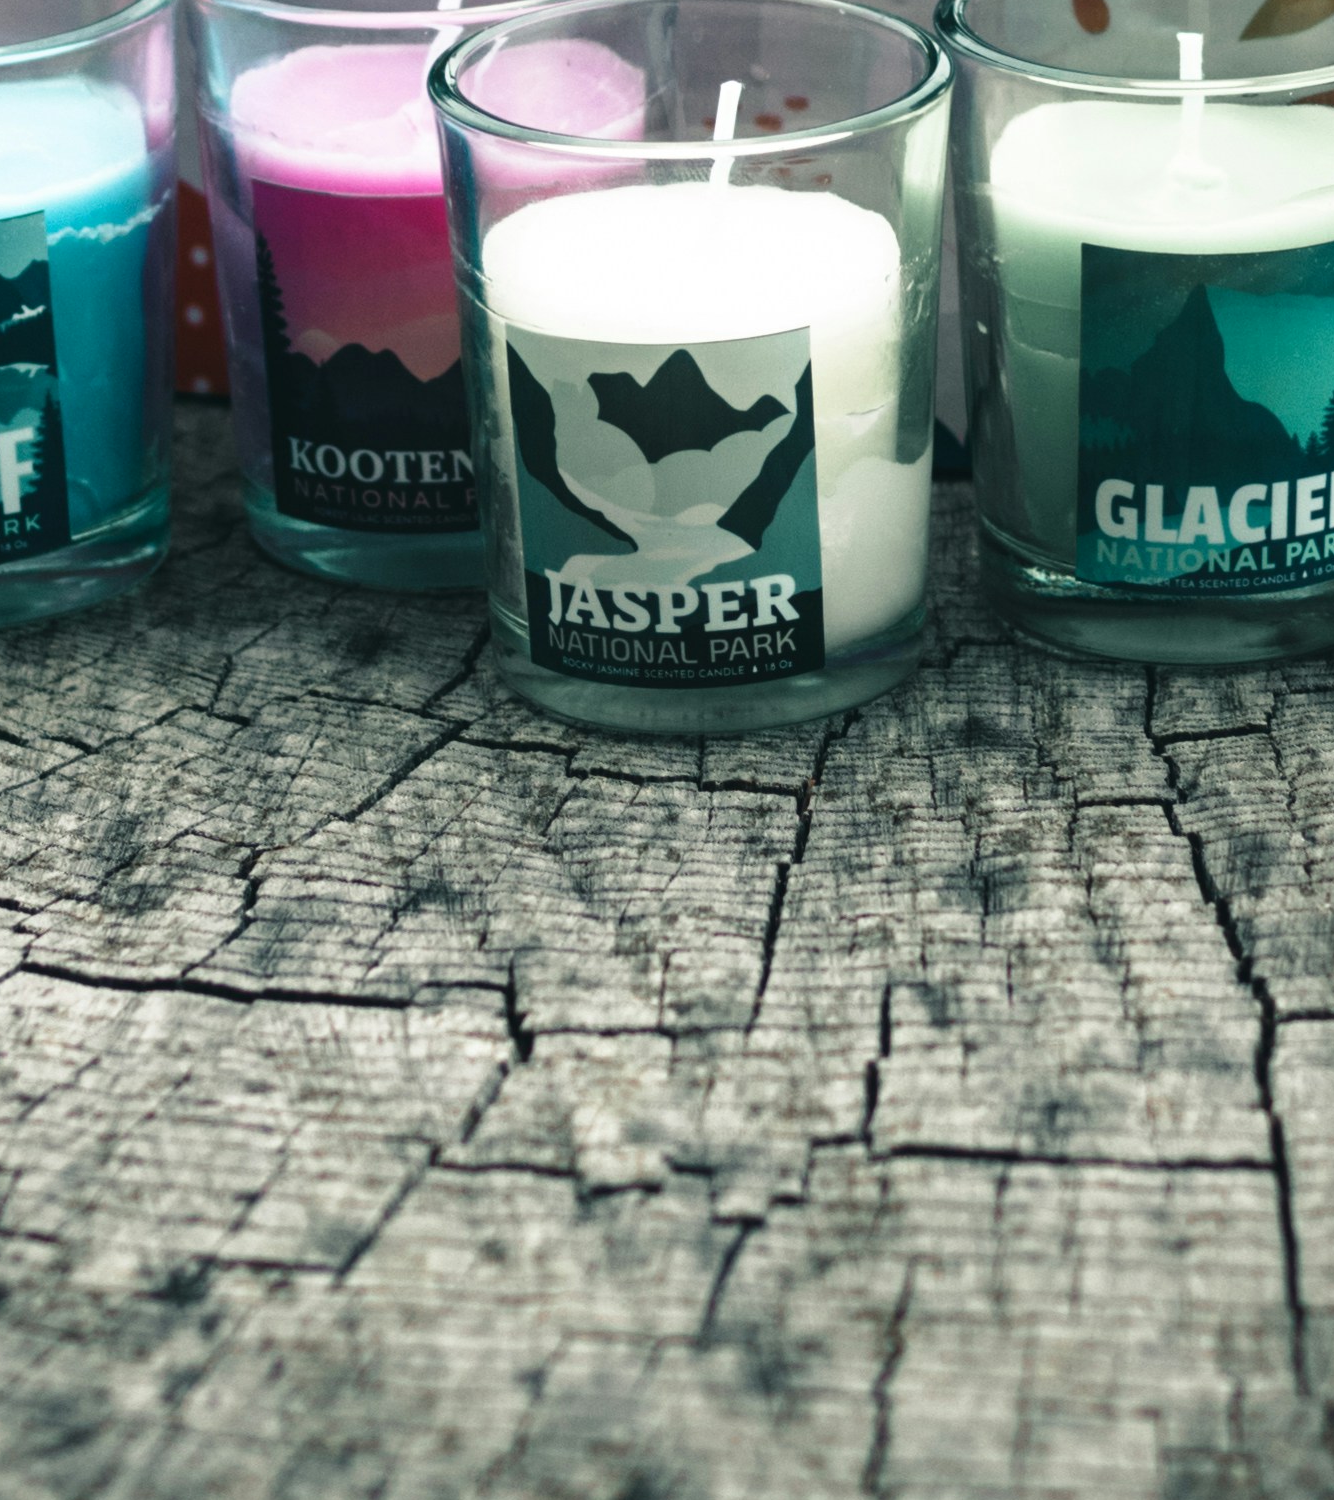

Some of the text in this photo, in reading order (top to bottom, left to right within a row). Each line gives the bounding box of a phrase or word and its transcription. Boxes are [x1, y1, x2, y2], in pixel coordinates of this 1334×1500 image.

[288, 436, 475, 483] KOOTEN
[294, 477, 450, 509] NATIONAL
[1097, 539, 1275, 573] NATIONAL
[1124, 574, 1170, 588] GLACIER
[1175, 578, 1195, 588] TEA
[1199, 578, 1250, 589] SCENTED
[1253, 572, 1296, 587] CANDLE
[544, 568, 800, 634] JASPER
[548, 623, 797, 664] NATIONAL PARK
[562, 655, 594, 672] ROCKY
[596, 665, 640, 678] JASMINE
[644, 669, 695, 680] SCENTED
[699, 665, 745, 679] CANDLE
